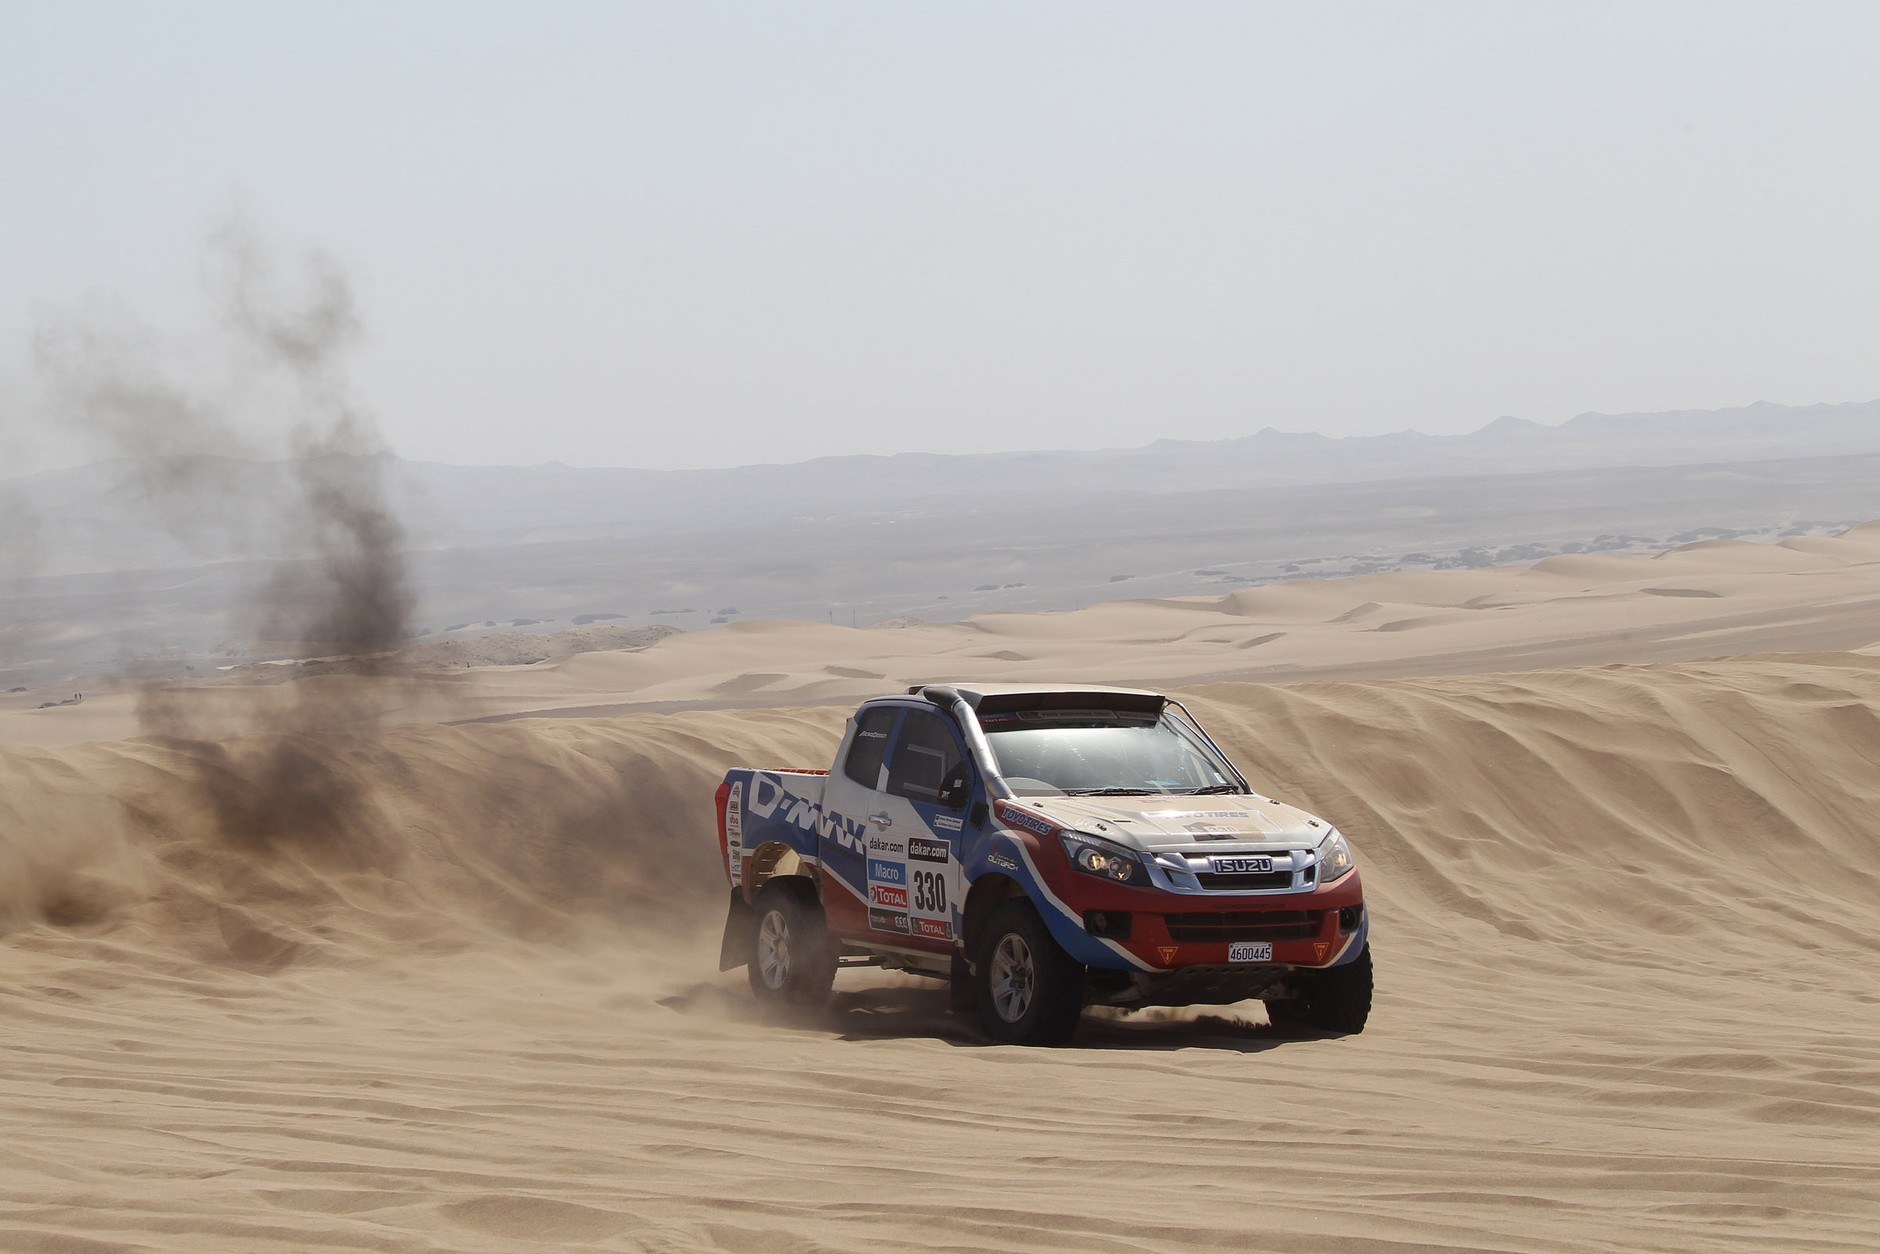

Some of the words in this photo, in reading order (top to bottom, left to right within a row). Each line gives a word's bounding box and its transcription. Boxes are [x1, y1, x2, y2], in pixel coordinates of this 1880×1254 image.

[869, 837, 904, 853] dakar.com
[910, 842, 947, 858] dakar.com
[875, 863, 899, 880] Macro
[1216, 859, 1271, 872] ISUZU
[878, 888, 907, 905] TOTAL
[913, 870, 946, 913] 330
[919, 921, 945, 935] TOTAL
[1230, 947, 1271, 960] 4600445
